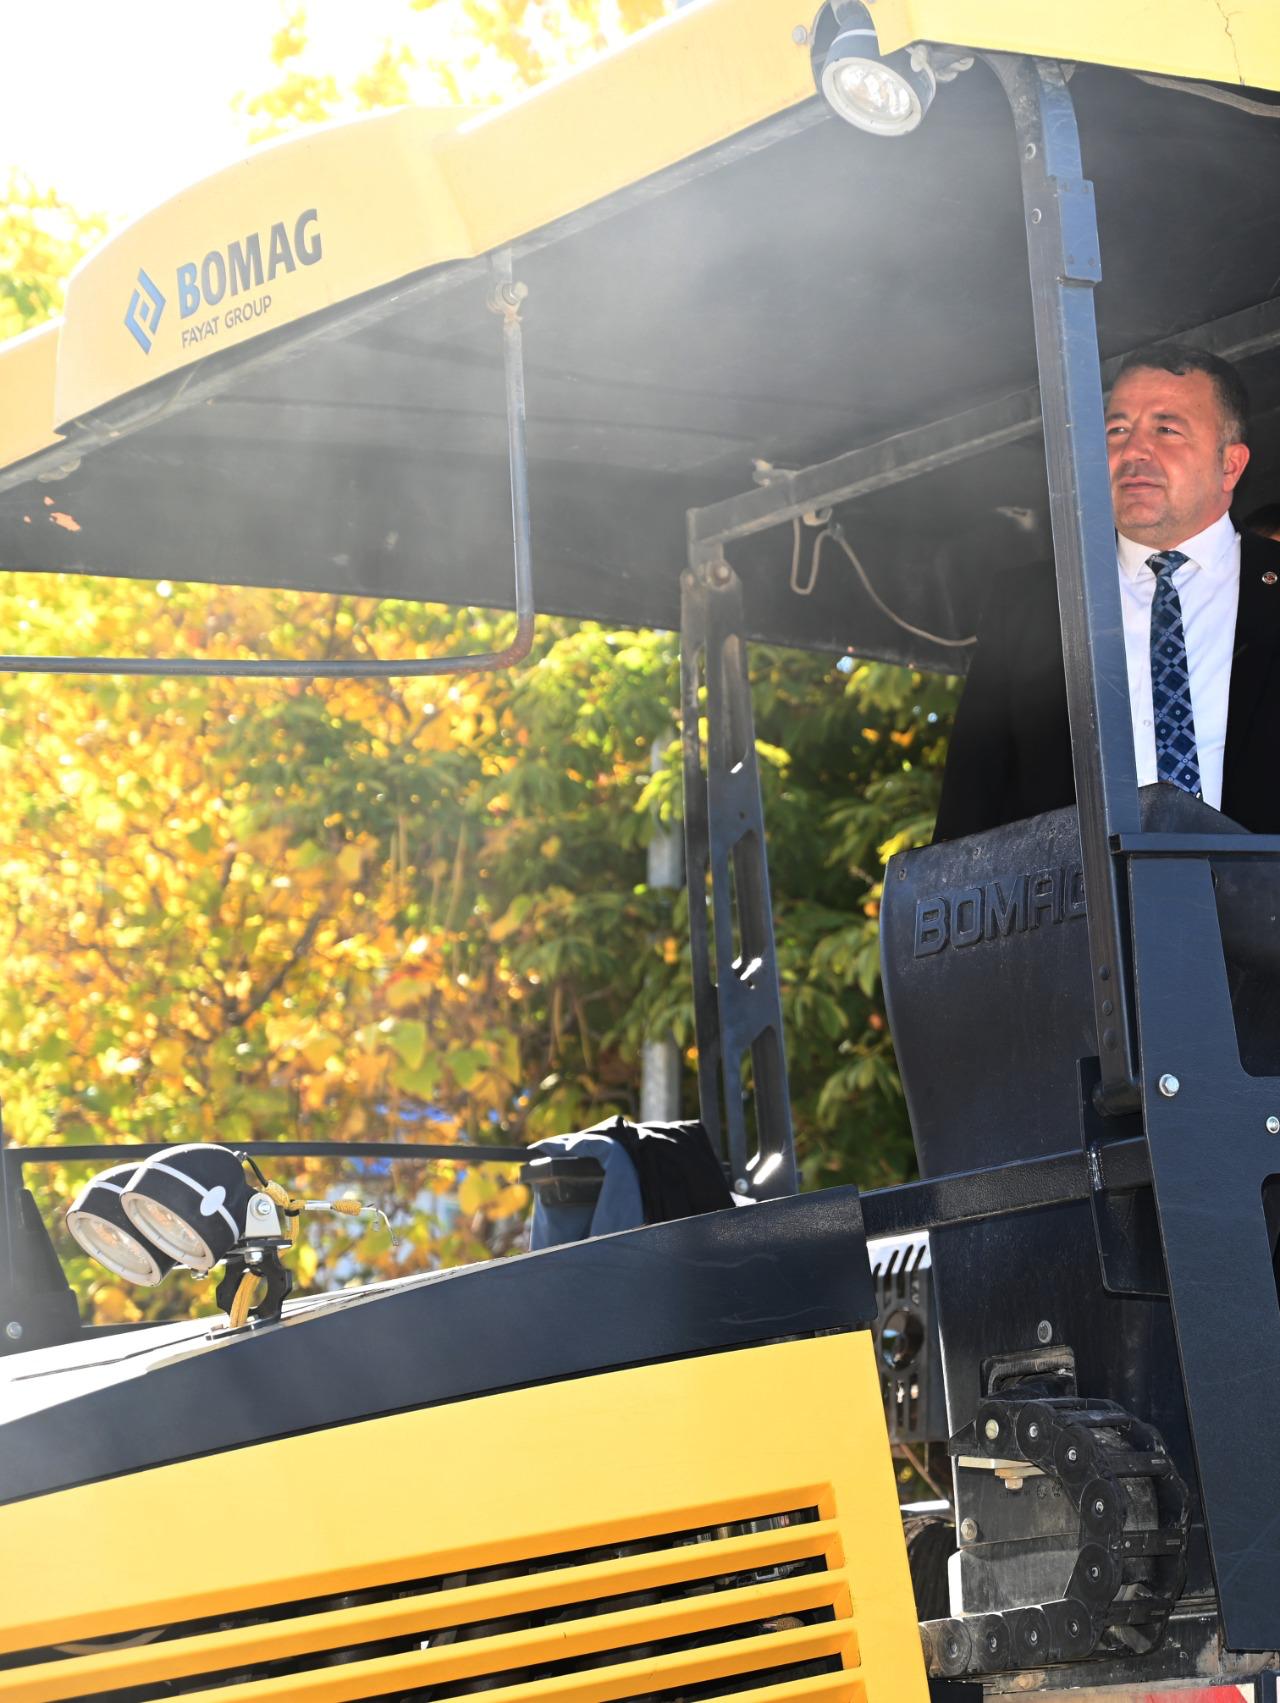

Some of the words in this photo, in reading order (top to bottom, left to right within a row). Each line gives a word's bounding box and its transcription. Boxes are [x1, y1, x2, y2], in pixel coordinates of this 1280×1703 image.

[176, 208, 322, 319] BOMAG
[181, 316, 219, 348] FAYAT
[224, 295, 272, 329] GROUP
